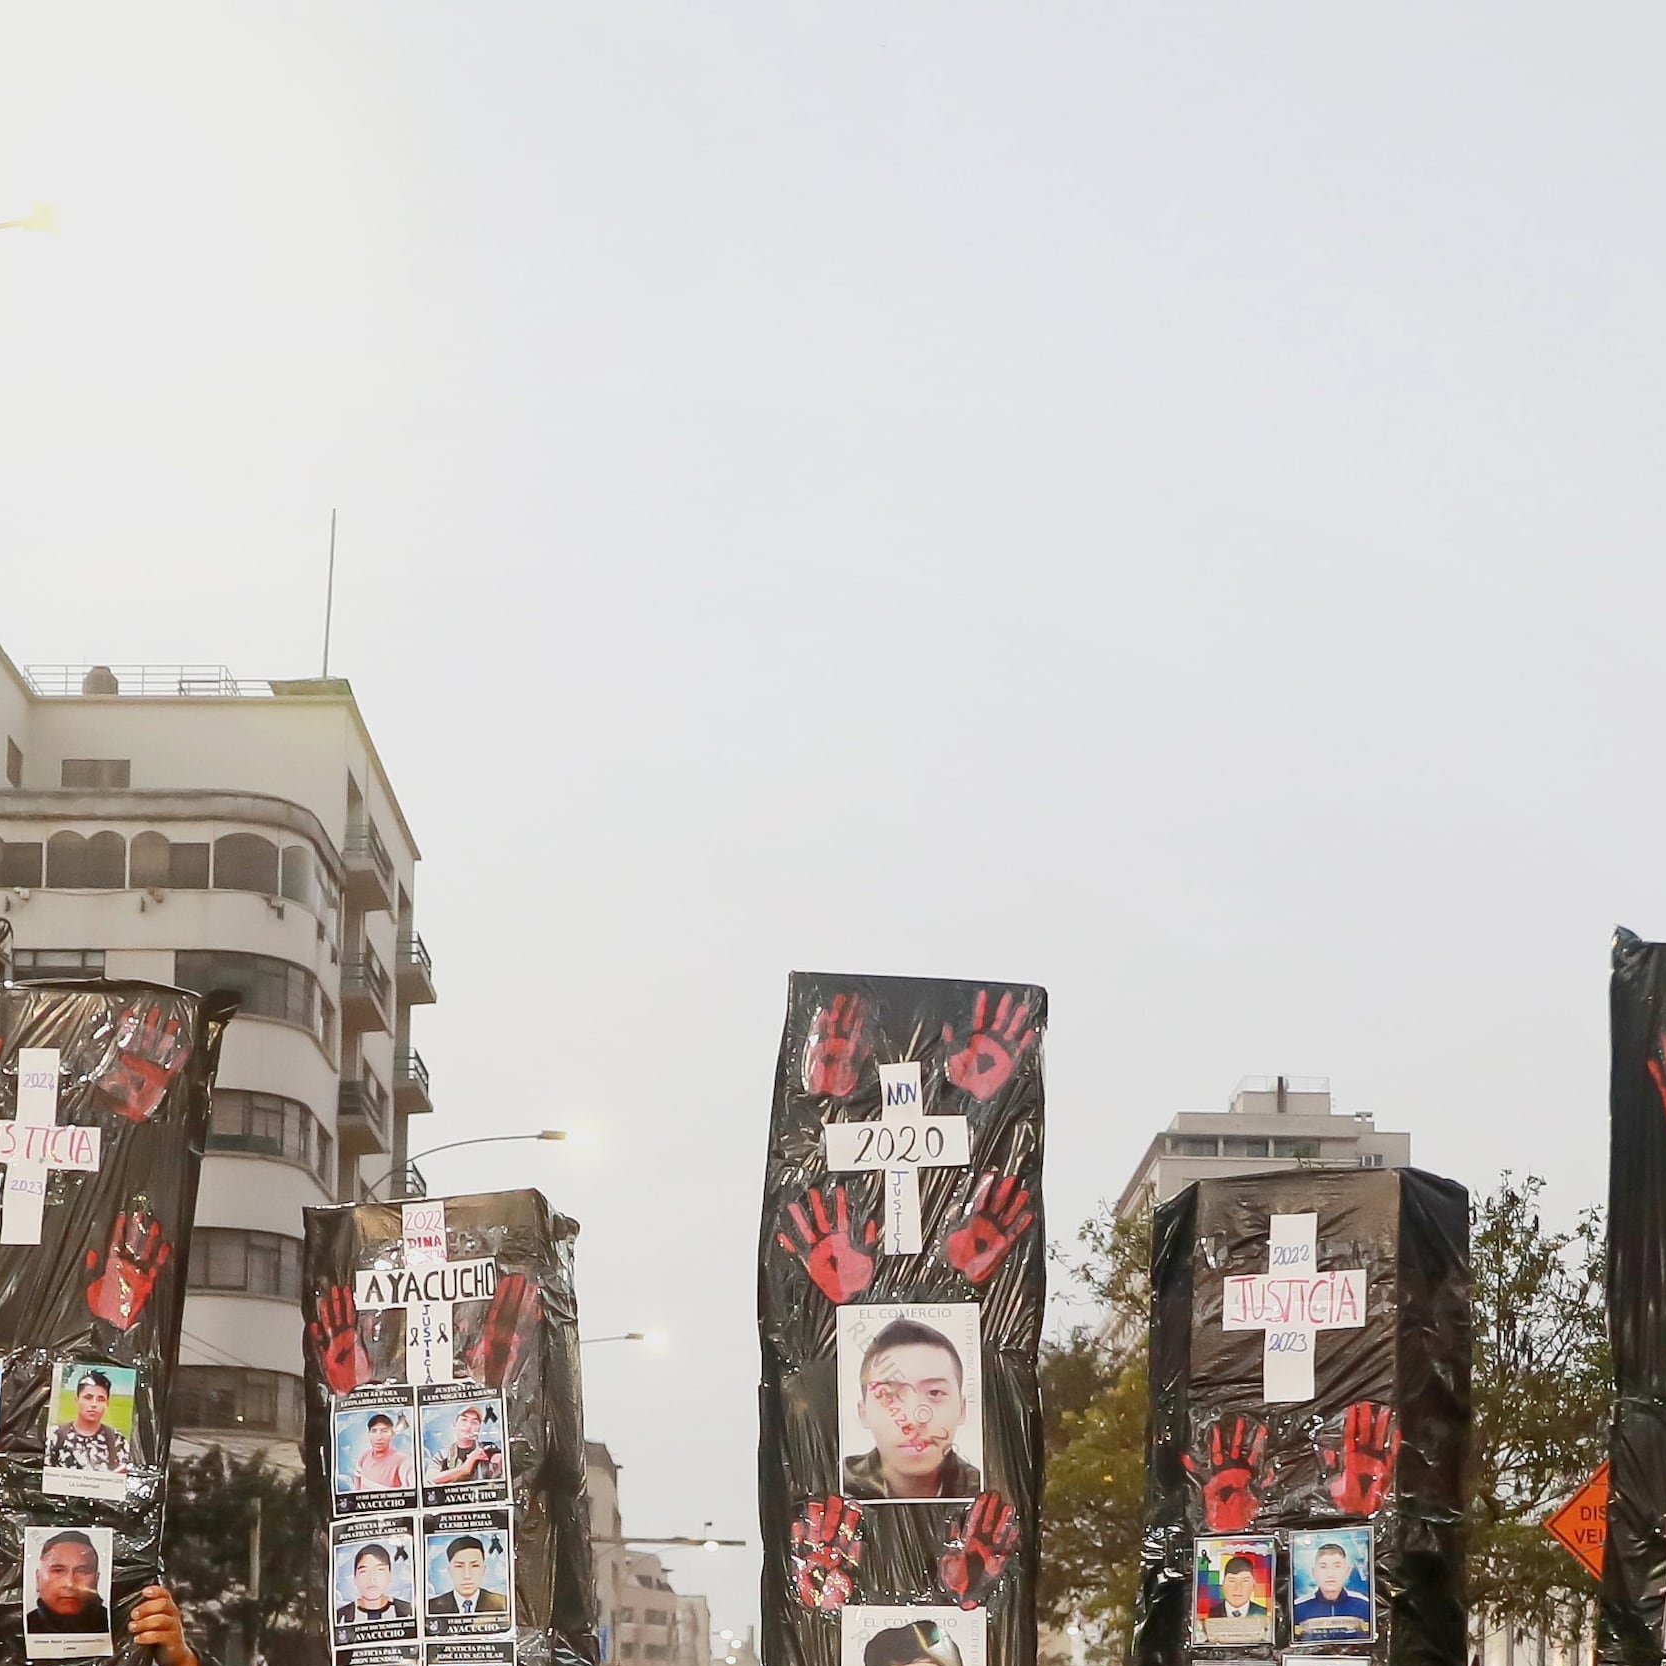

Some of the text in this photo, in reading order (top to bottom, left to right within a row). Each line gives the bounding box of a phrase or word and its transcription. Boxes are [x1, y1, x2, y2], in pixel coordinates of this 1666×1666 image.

[887, 1081, 916, 1106] NOV
[853, 1126, 944, 1165] 2020
[404, 1210, 443, 1231] 2022
[406, 1235, 442, 1249] DINA
[364, 1261, 496, 1303] AYACUCHO
[1230, 1271, 1359, 1324] JUSTICIA
[859, 1308, 951, 1319] EL COMERCIO
[422, 1304, 434, 1384] JUSTICIA
[1269, 1333, 1308, 1353] 2023
[356, 1500, 405, 1510] AYACUCHO
[355, 1630, 405, 1641] AYACUCHO
[446, 1623, 499, 1633] AYACUCHO
